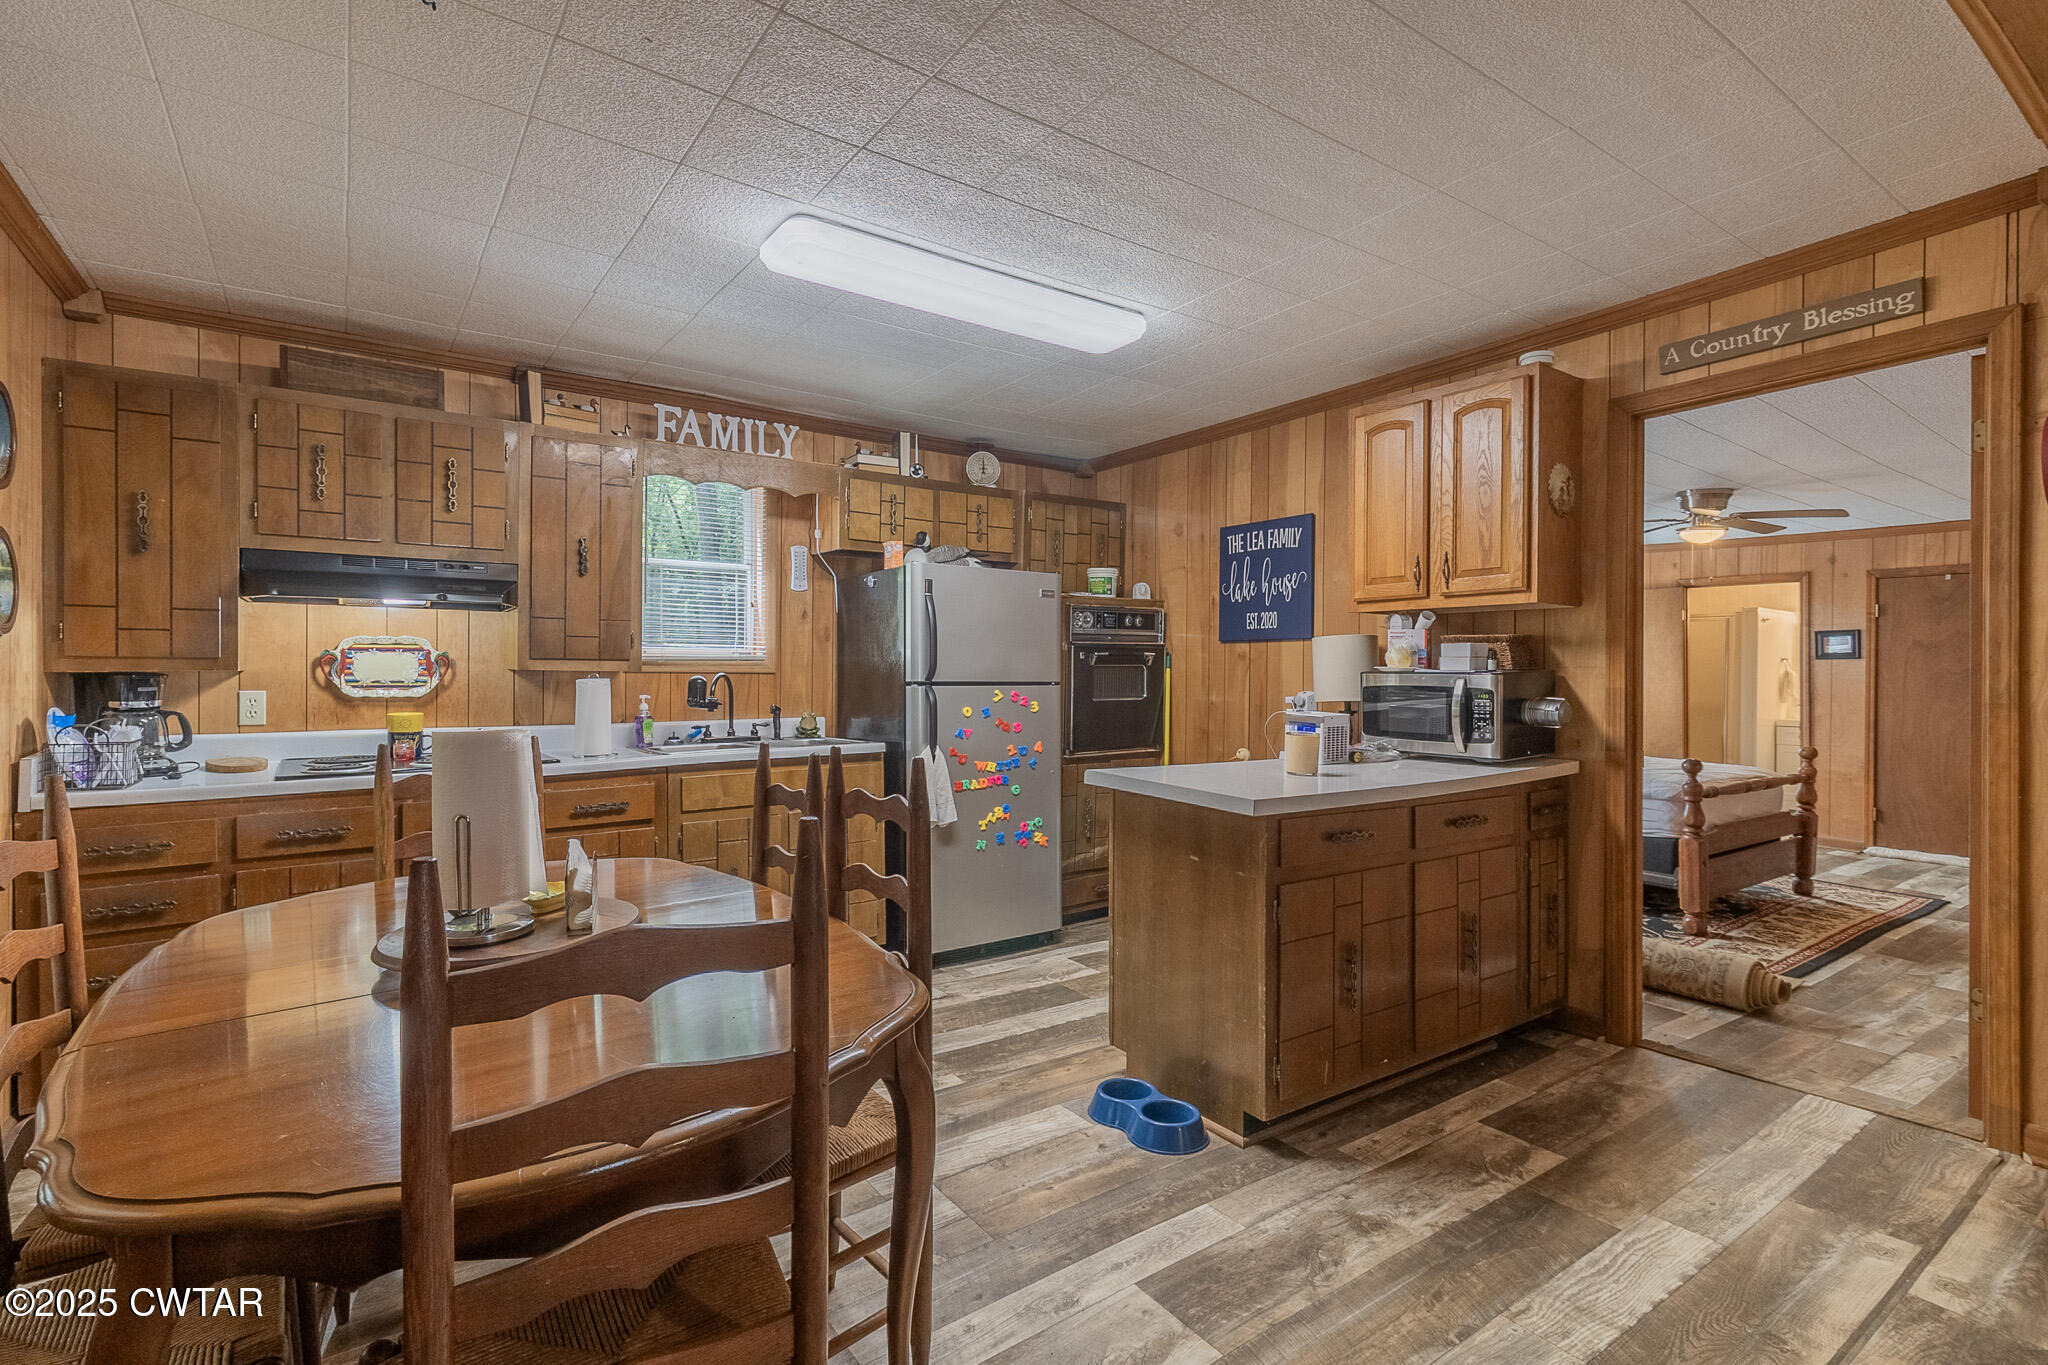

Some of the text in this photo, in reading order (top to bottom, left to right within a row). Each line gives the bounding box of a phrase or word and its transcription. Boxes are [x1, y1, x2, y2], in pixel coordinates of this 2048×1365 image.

[1664, 290, 1915, 365] A Country Blessing
[653, 403, 800, 460] FAMILY
[1227, 527, 1303, 555] THE LEA FAMILY
[1222, 556, 1307, 607] lake house
[1246, 611, 1277, 630] EST. 2020
[974, 757, 1020, 773] WHITE
